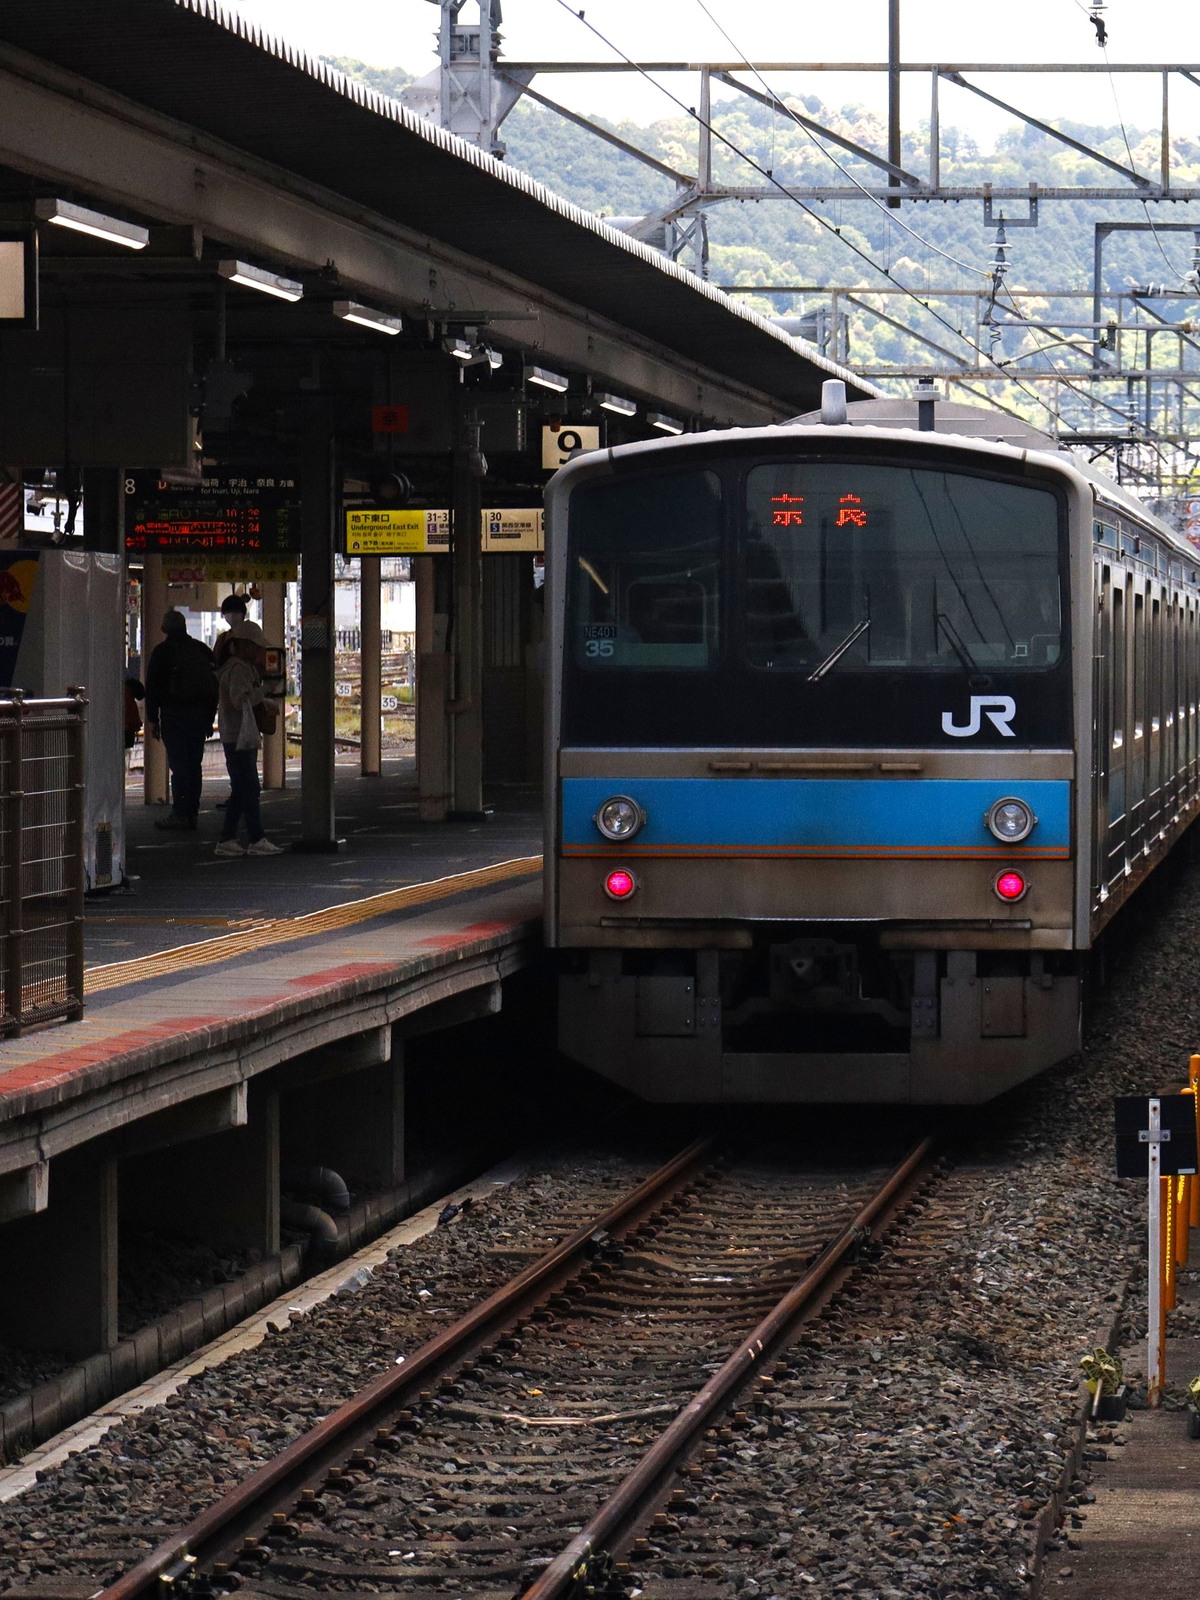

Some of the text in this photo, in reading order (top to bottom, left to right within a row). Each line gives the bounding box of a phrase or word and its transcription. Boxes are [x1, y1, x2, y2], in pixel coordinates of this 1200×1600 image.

[557, 430, 582, 464] 9
[125, 478, 136, 494] 8
[351, 514, 390, 522] 地下東口
[490, 512, 502, 521] 30
[584, 626, 615, 638] NE401
[585, 639, 615, 657] 35
[338, 685, 350, 694] 35
[382, 697, 396, 708] 35
[941, 695, 1016, 737] JR
